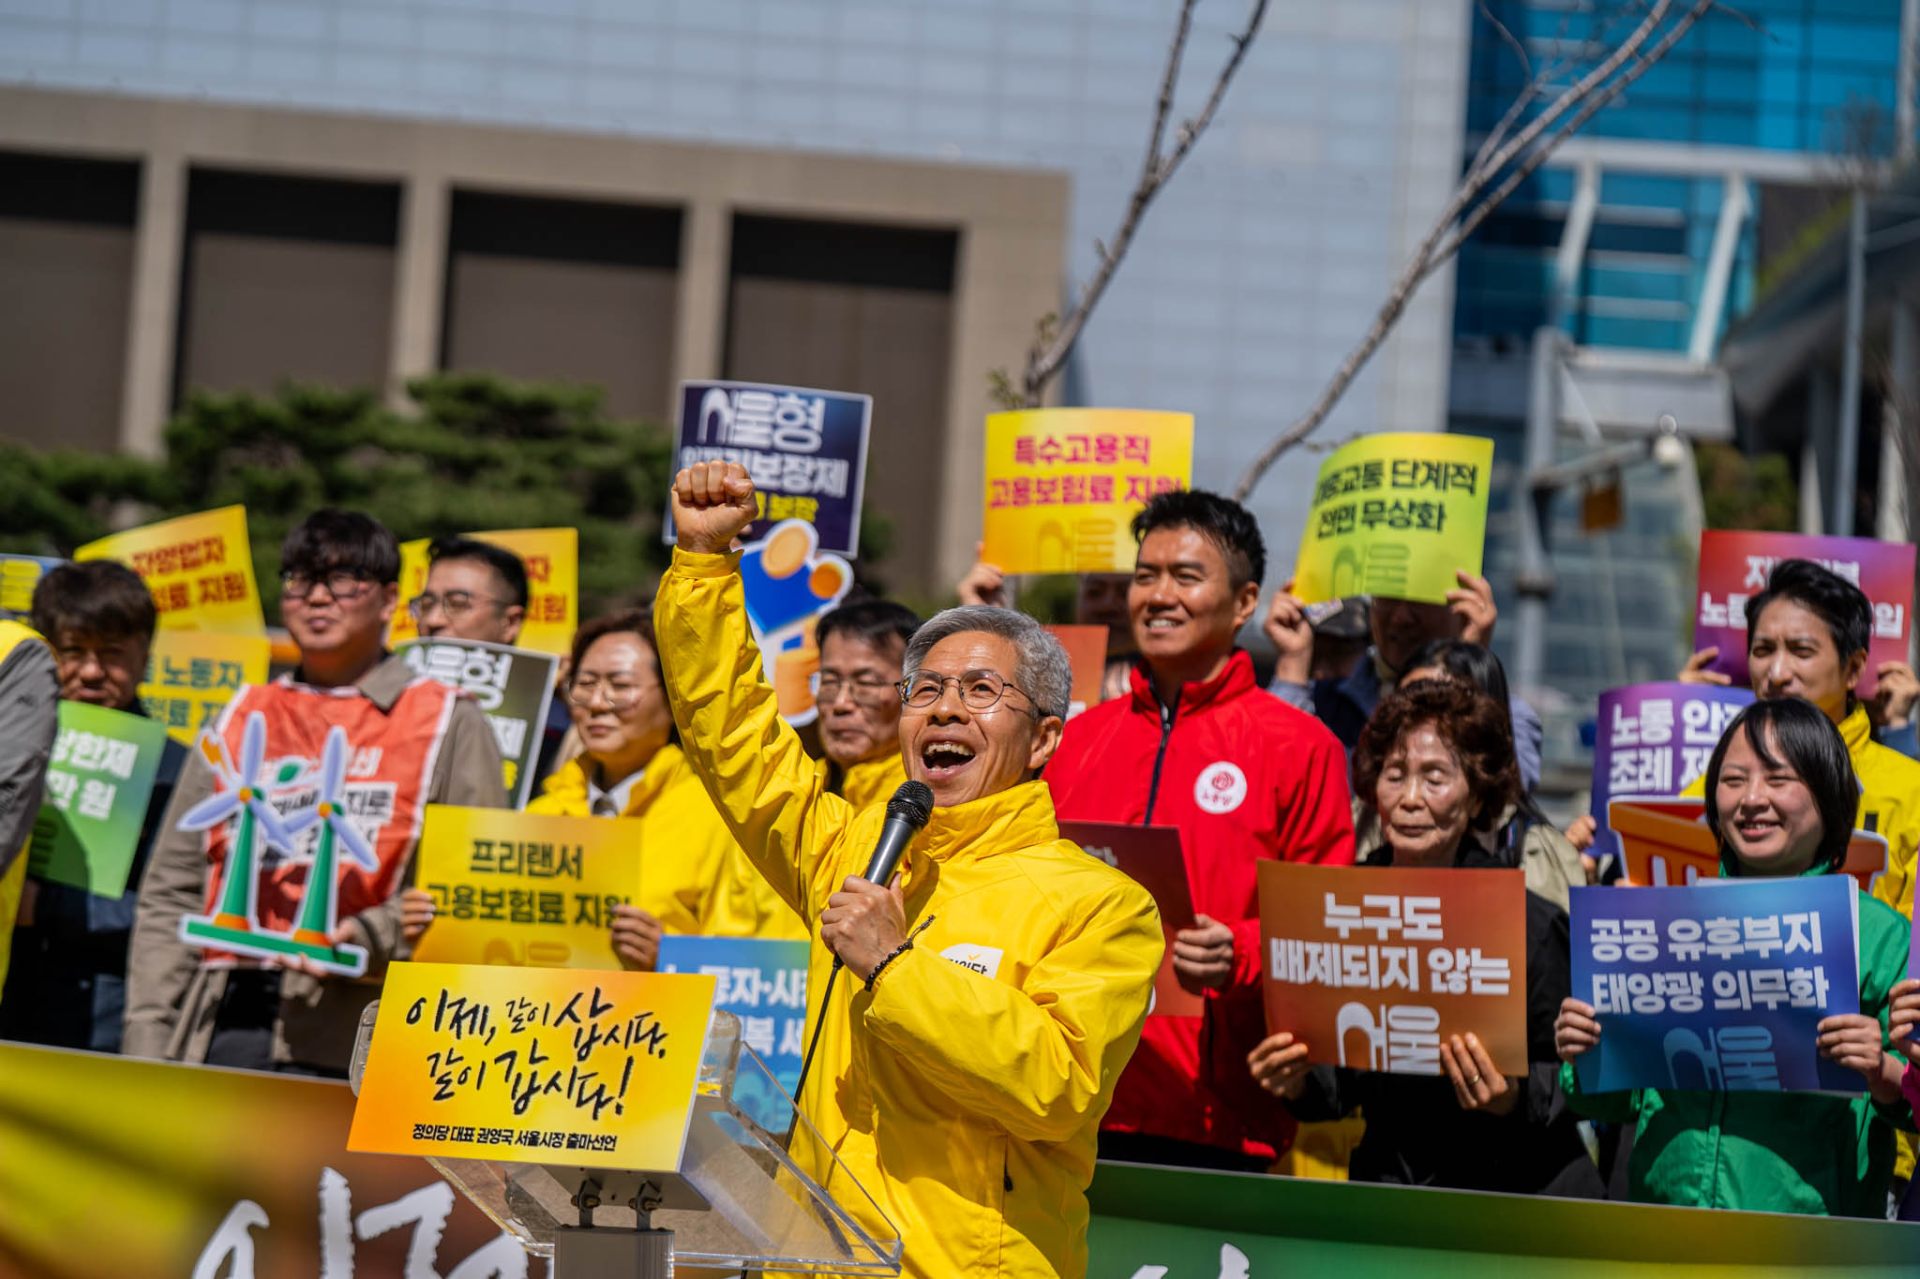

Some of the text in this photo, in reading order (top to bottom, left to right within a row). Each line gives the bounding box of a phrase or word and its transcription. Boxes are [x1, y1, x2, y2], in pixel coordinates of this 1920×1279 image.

[1014, 434, 1151, 466] 특수고용직
[989, 475, 1116, 509] 고용보험료
[1391, 458, 1478, 497] 단계적
[1317, 499, 1446, 539] 전면 무상화
[1610, 698, 1675, 747] 노동
[1608, 747, 1673, 794] 조례
[470, 838, 584, 881] 프리랜서
[426, 883, 566, 925] 고용보험료
[1324, 892, 1443, 941] 누구도
[1590, 918, 1659, 962] 공공
[1270, 937, 1510, 995] 배제되지 않는
[1591, 965, 1830, 1014] 태양광 의무화
[405, 989, 496, 1046] 이제,
[494, 1038, 634, 1121] 갑시다!
[412, 1123, 618, 1152] 정의당 대표 권영국 서울시장 출마선언
